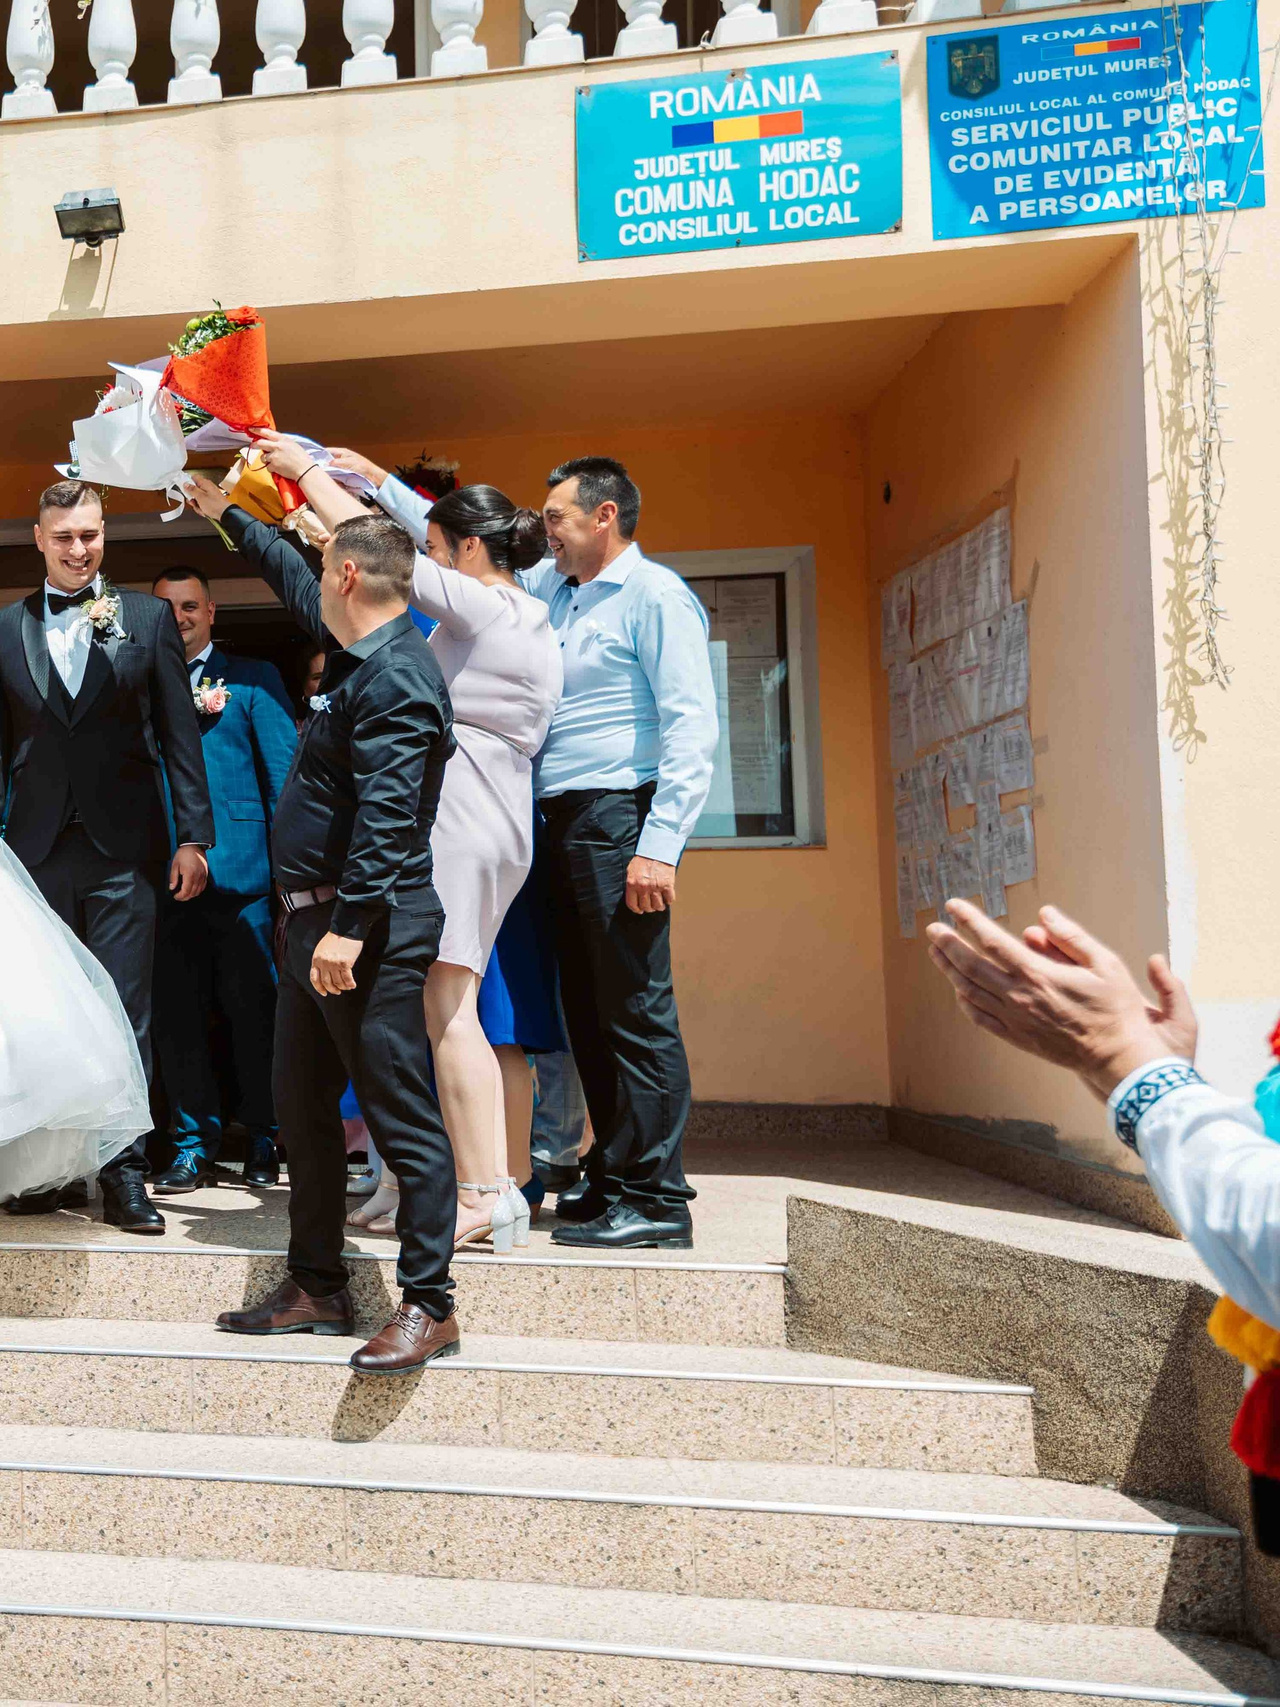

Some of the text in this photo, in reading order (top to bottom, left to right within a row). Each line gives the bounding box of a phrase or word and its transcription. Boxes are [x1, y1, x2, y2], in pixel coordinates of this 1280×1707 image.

[1021, 19, 1159, 44] ROMÂNIA
[1013, 64, 1098, 85] JUDEȚUL
[940, 103, 1025, 122] CONSILIUL
[1030, 96, 1082, 112] LOCAL
[1087, 92, 1108, 106] AL
[1194, 77, 1251, 93] HODAC
[951, 97, 1238, 147] SERVICIUL PUBLIC
[634, 136, 843, 180] JUDEȚUL MUREȘ
[948, 124, 1246, 174] COMUNITAR LOCAL
[614, 163, 860, 217] COMUNA HODAC
[969, 179, 1227, 224] A PERSOANELOR
[994, 173, 1034, 195] DE
[618, 201, 860, 246] CONSILIUL LOCAL
